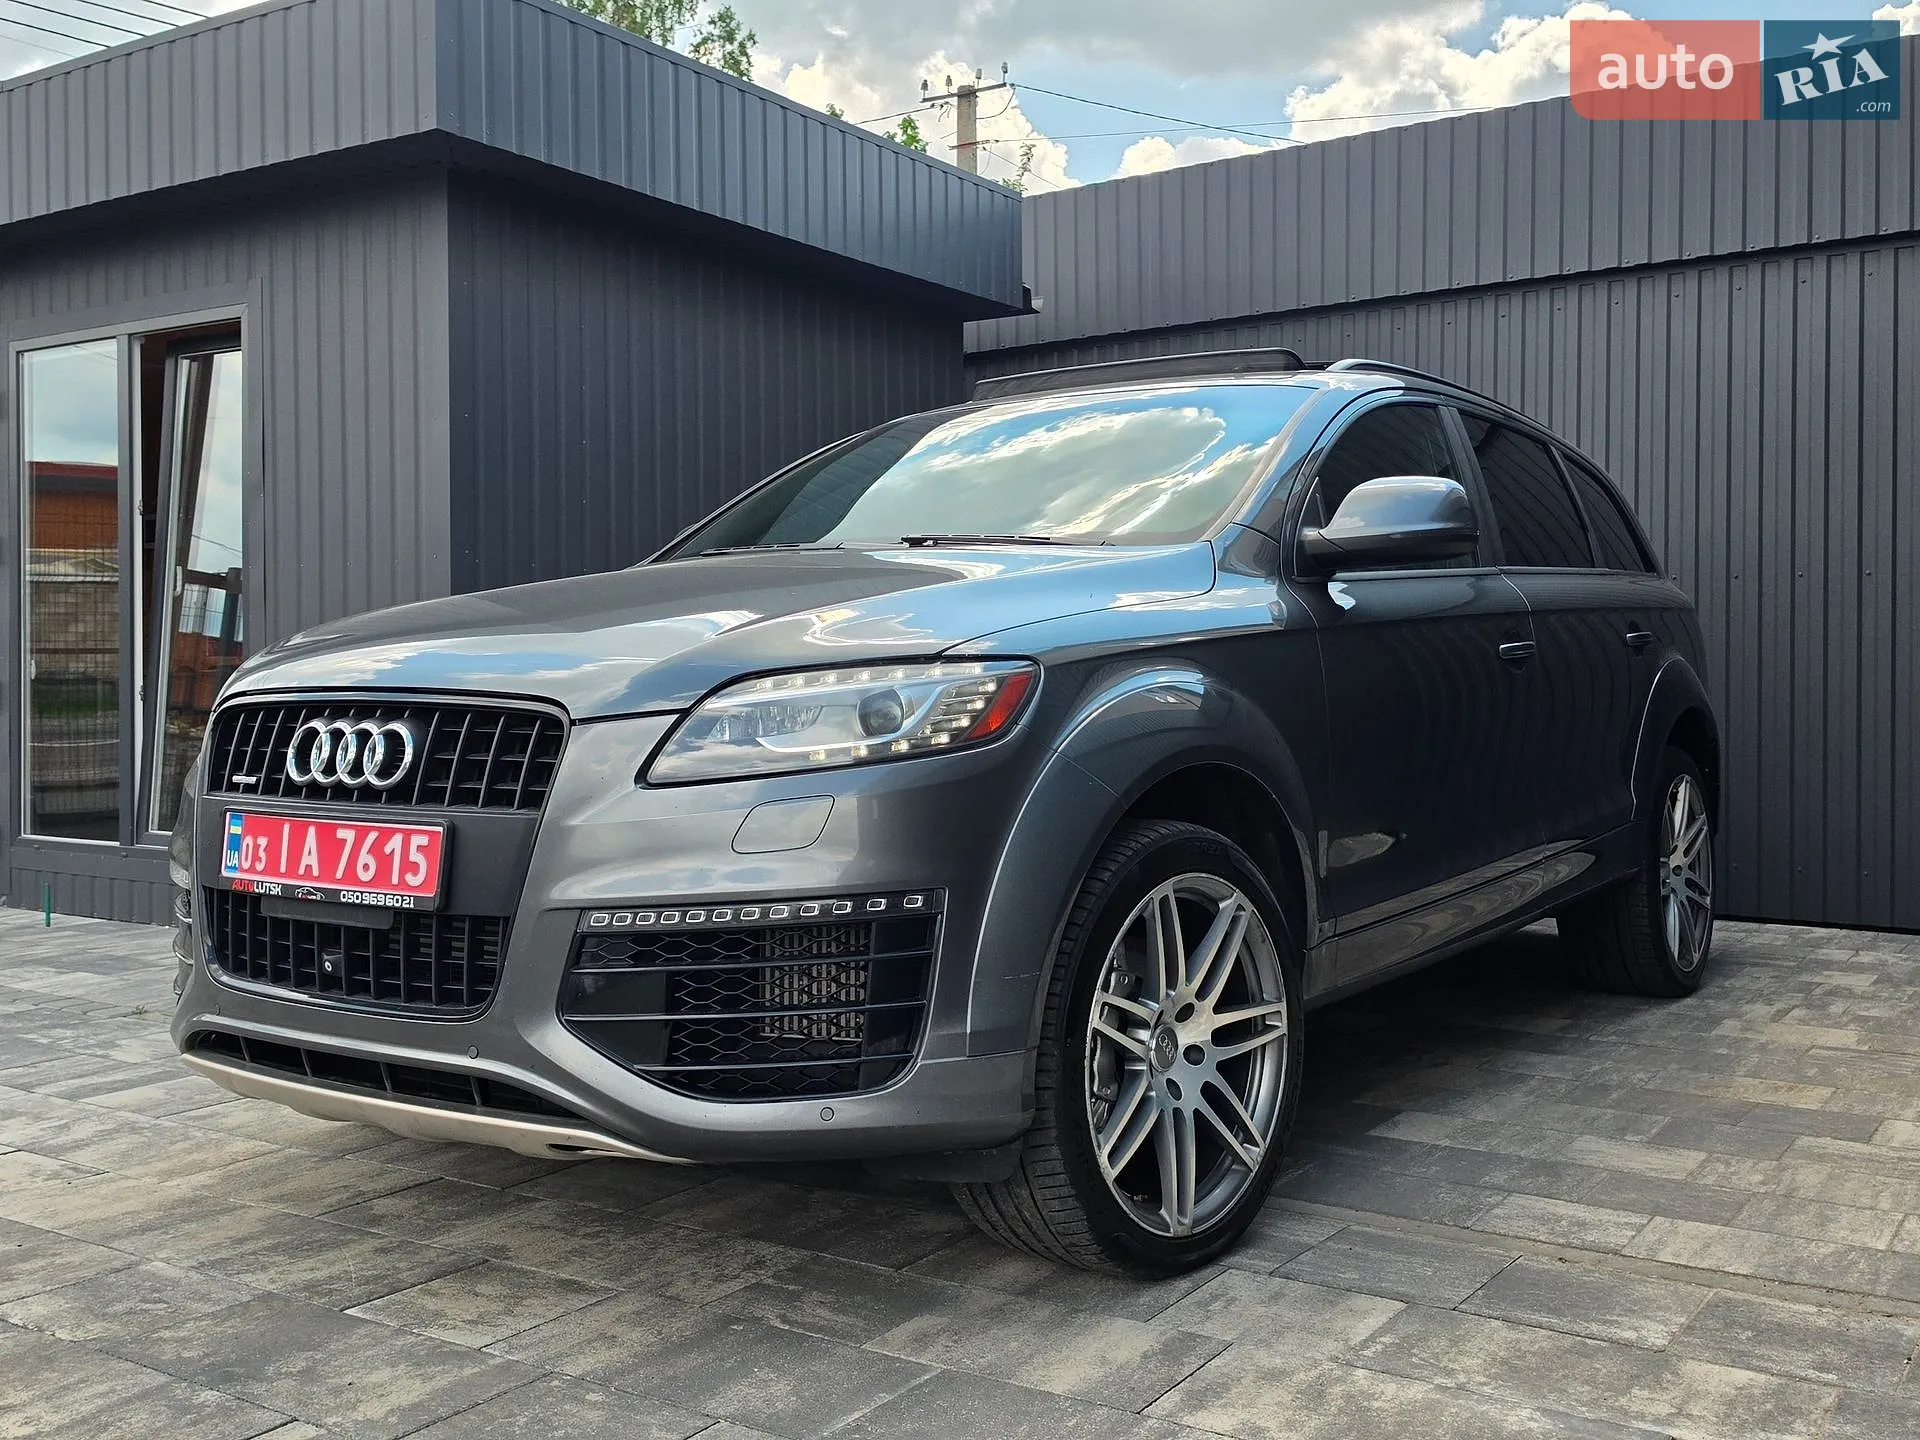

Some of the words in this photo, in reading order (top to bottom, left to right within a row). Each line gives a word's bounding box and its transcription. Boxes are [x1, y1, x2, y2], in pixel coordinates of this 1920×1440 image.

[227, 849, 239, 868] UA
[241, 835, 269, 872] 03
[279, 823, 320, 878] IA
[335, 828, 429, 888] 7615
[340, 891, 415, 909] 0509696021
